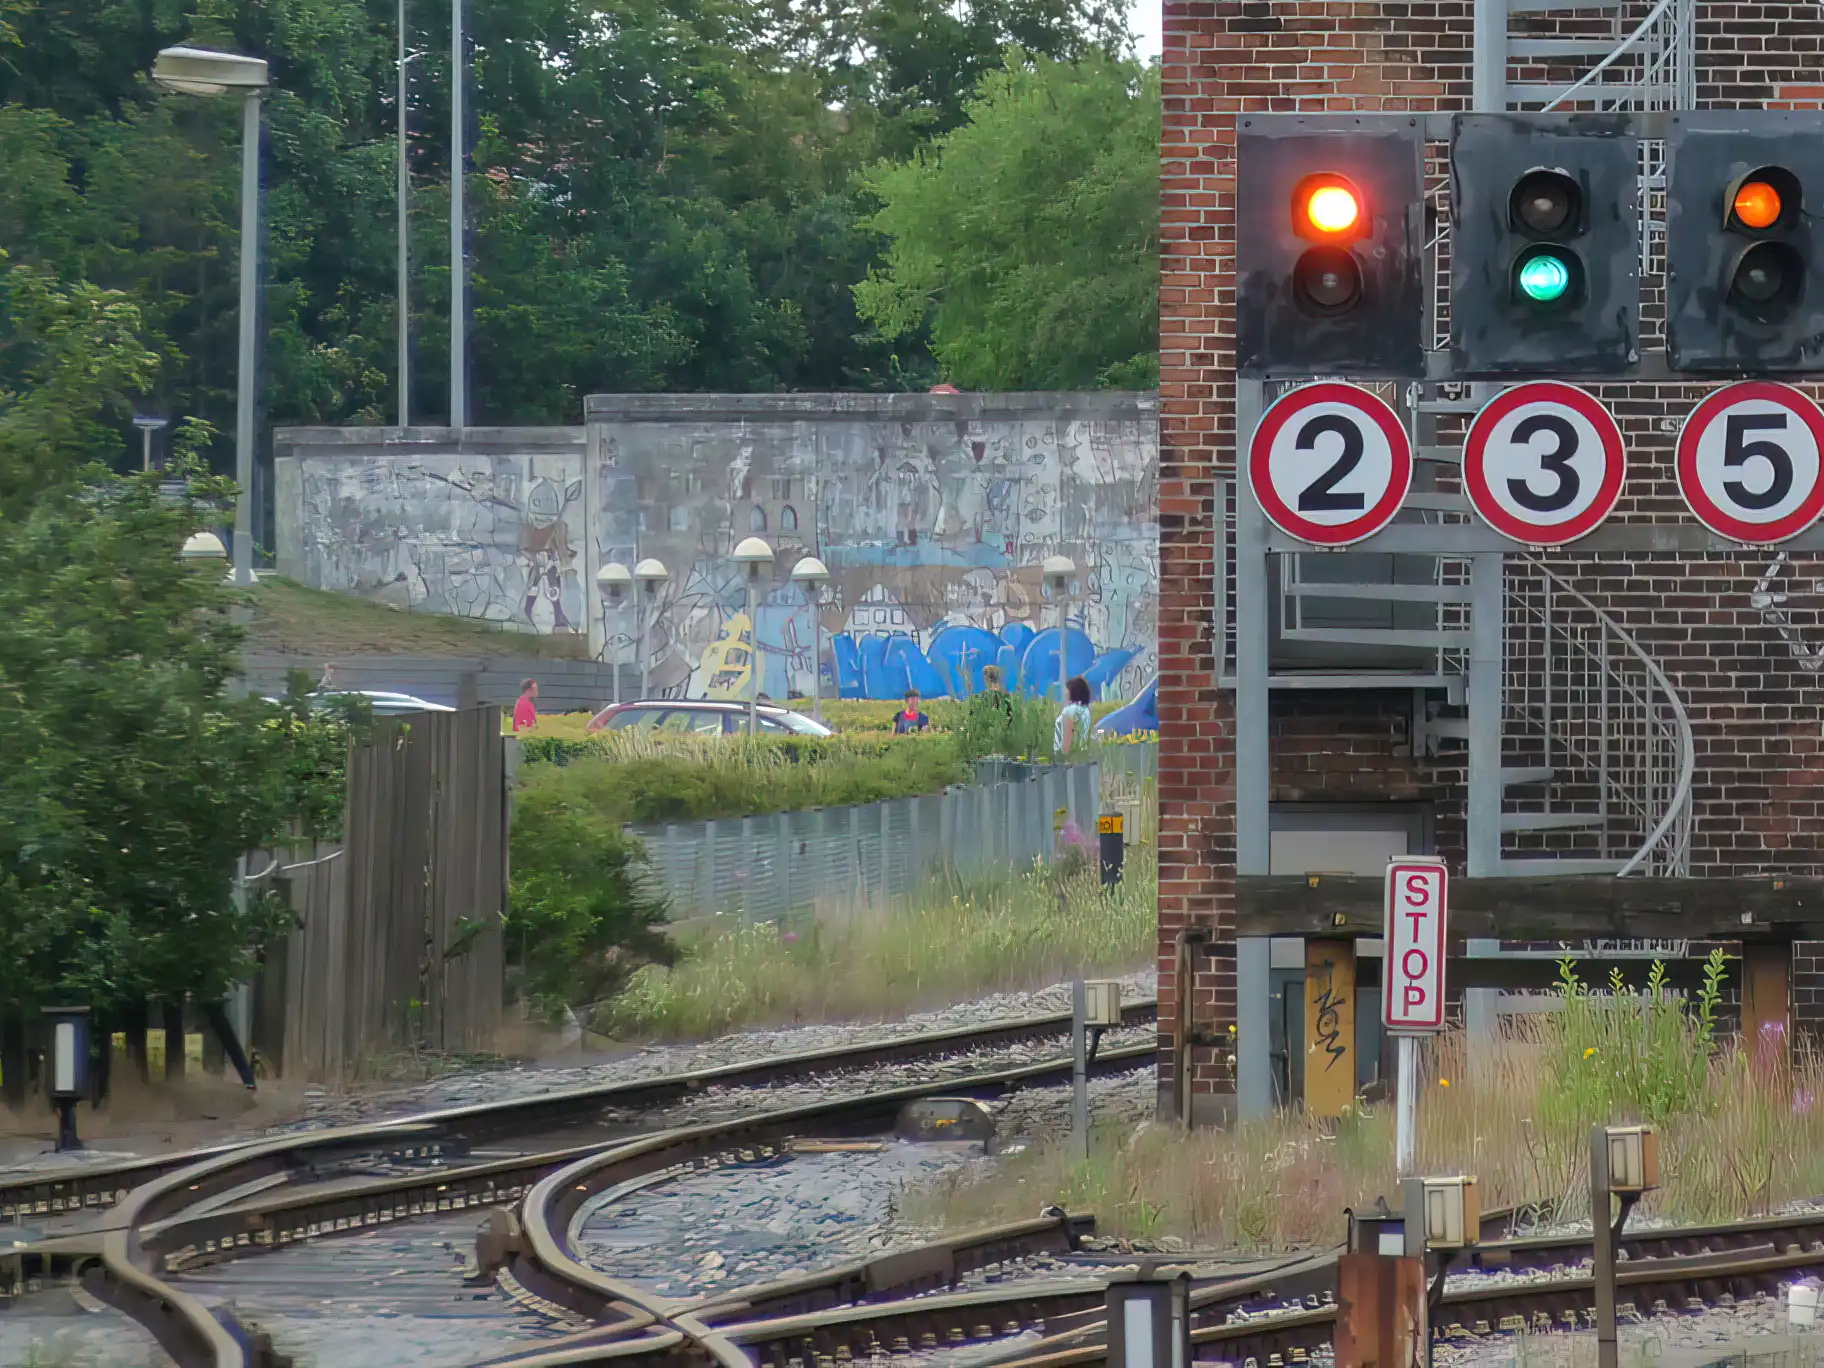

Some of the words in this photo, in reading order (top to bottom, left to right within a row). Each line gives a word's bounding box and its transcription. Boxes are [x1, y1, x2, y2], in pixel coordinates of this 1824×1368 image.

[1294, 414, 1365, 512] 2
[1506, 414, 1581, 513] 3
[1722, 412, 1793, 510] 5
[1402, 875, 1430, 1016] STOP
